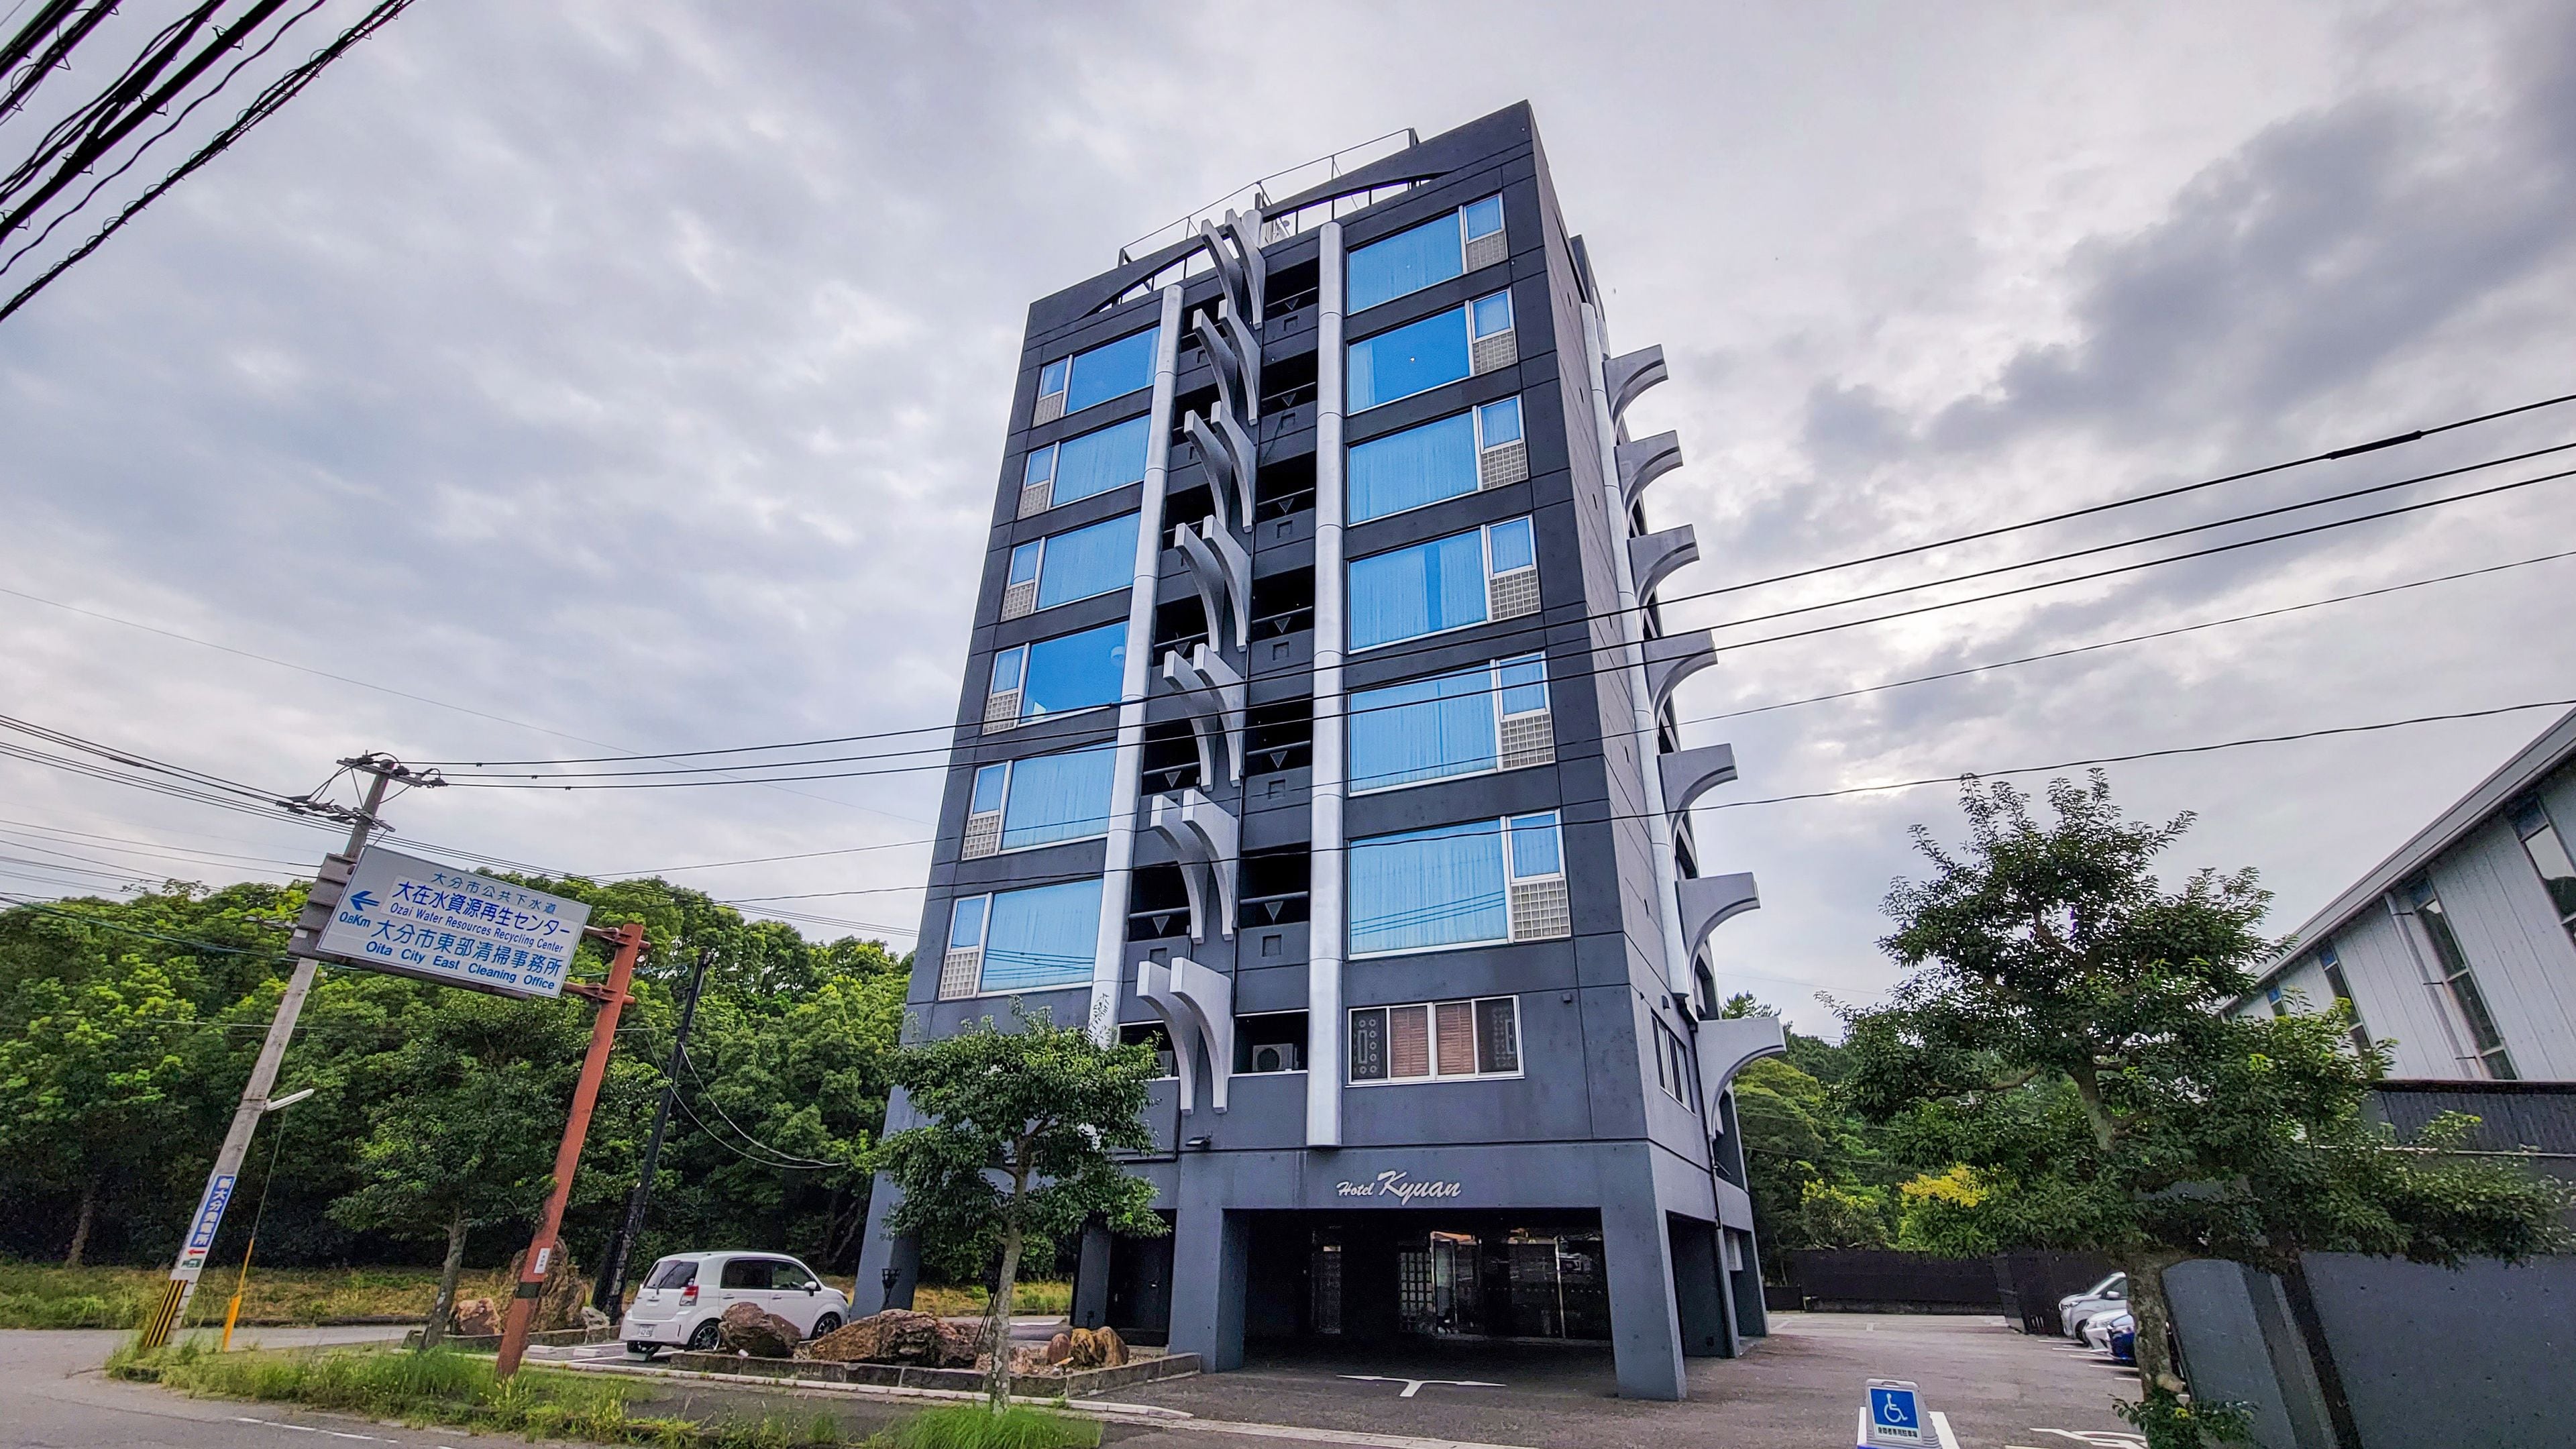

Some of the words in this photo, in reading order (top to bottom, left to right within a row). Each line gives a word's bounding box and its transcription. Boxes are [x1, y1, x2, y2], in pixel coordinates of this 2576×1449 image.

[392, 881, 570, 936] 大在水資源再生センター
[431, 873, 557, 914] 大分市公共下水道
[371, 920, 564, 977] 大分市東部清掃事務所
[390, 902, 413, 917] Ozai
[416, 908, 443, 924] Water
[445, 915, 492, 936] Resources
[493, 928, 535, 947] Recycling
[537, 938, 564, 953] Center
[366, 941, 392, 956] Oita
[400, 948, 425, 965] City
[433, 955, 460, 970] East
[468, 962, 517, 983] Cleaning
[523, 975, 555, 989] Office
[1336, 1180, 1375, 1196] Hotel
[1377, 1170, 1461, 1205] Kyuan
